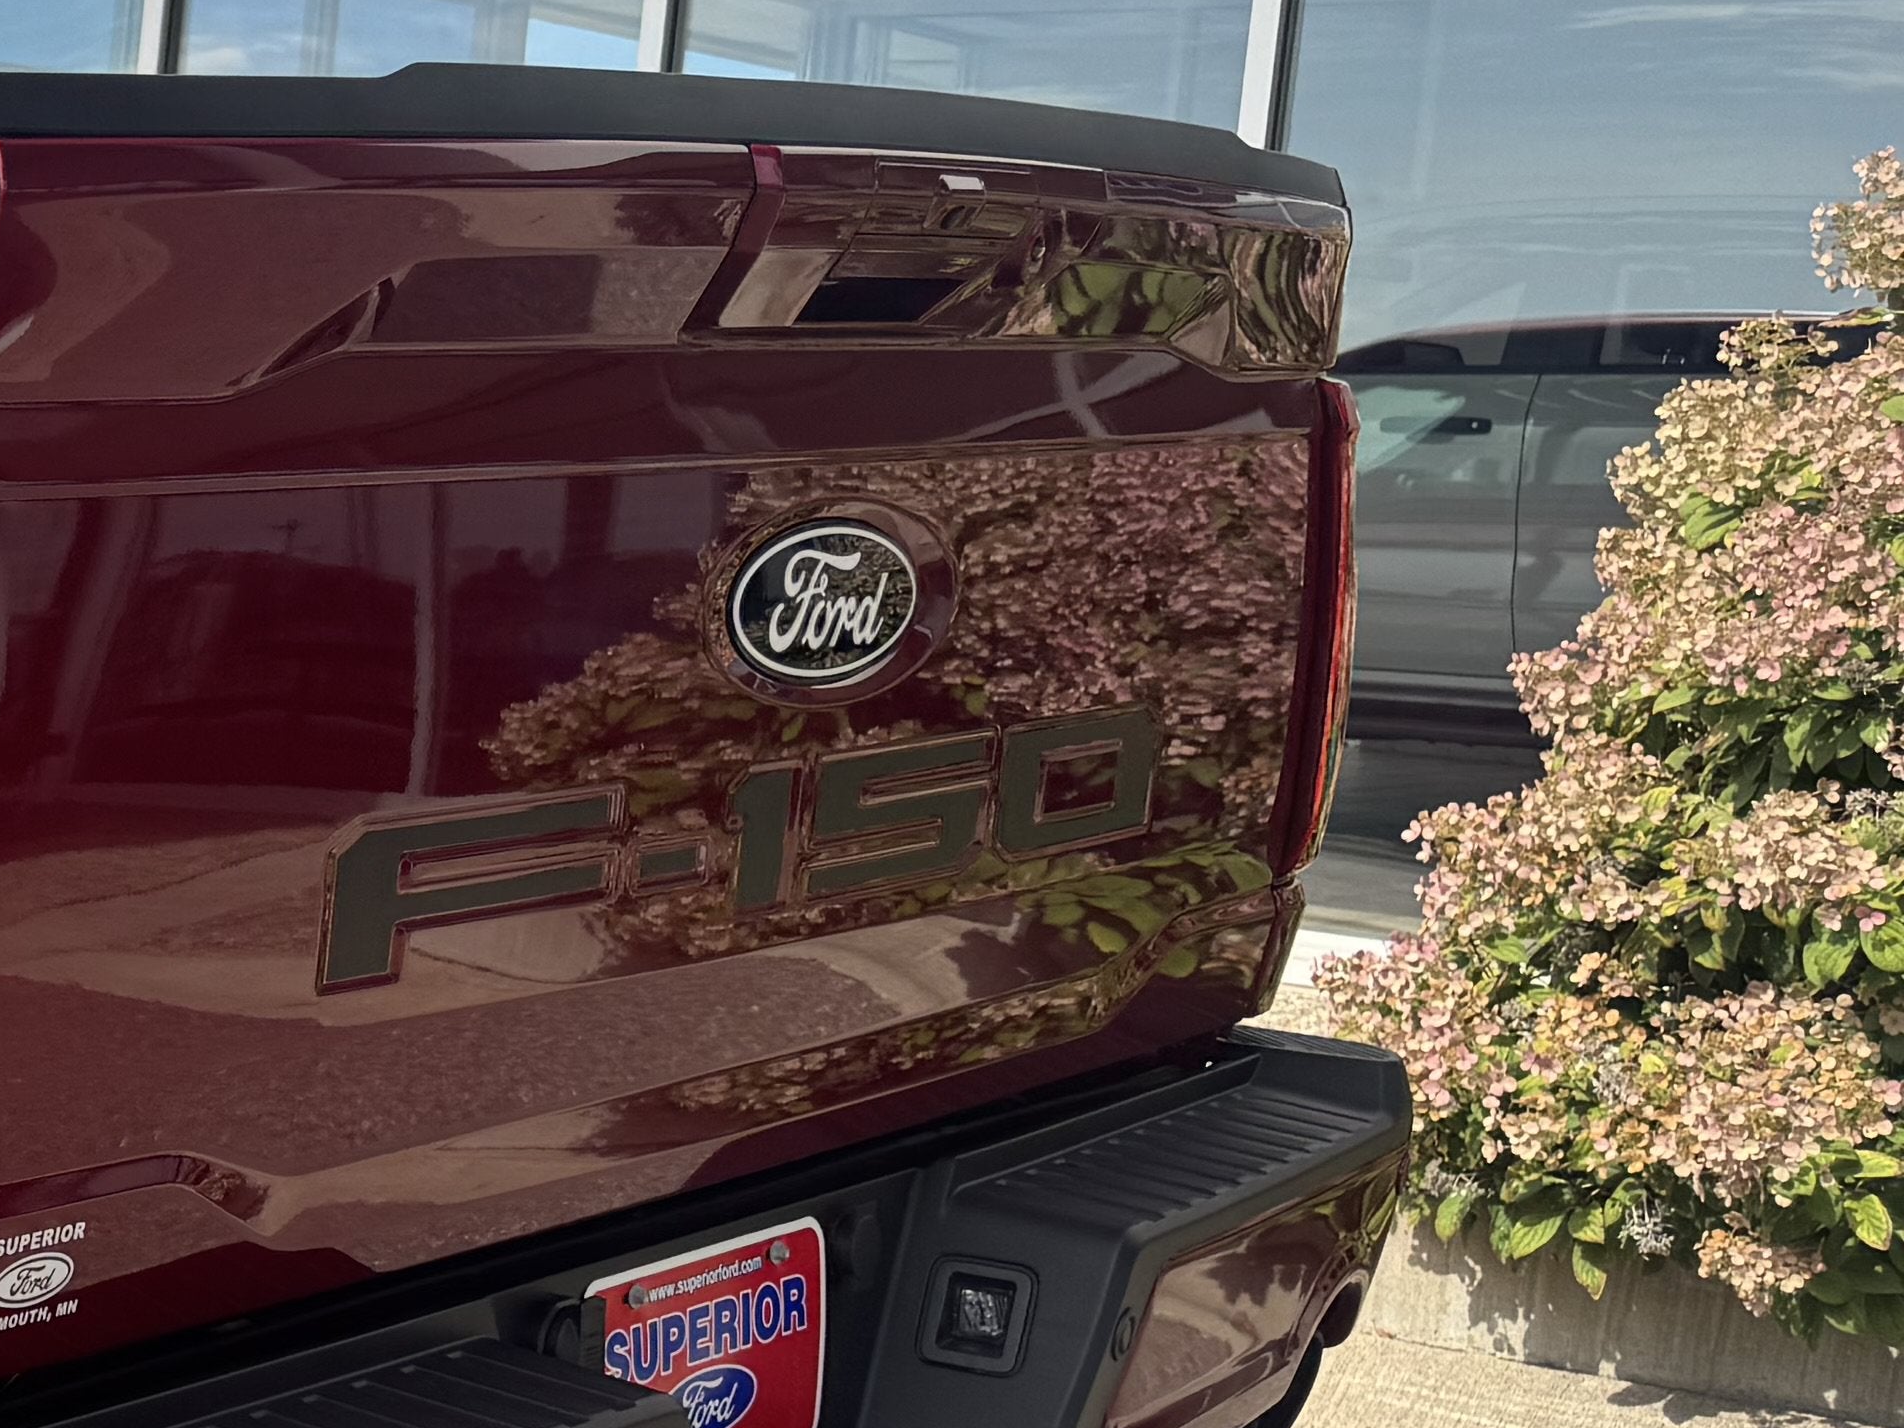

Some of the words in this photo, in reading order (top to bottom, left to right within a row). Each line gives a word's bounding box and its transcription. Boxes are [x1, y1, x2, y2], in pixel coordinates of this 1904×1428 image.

[769, 550, 889, 653] Ford
[314, 702, 1166, 998] F-150
[10, 1265, 57, 1297] Ford
[55, 1299, 79, 1318] MN
[648, 1256, 762, 1303] www.superiorford.com
[604, 1273, 808, 1385] SUPERIOR
